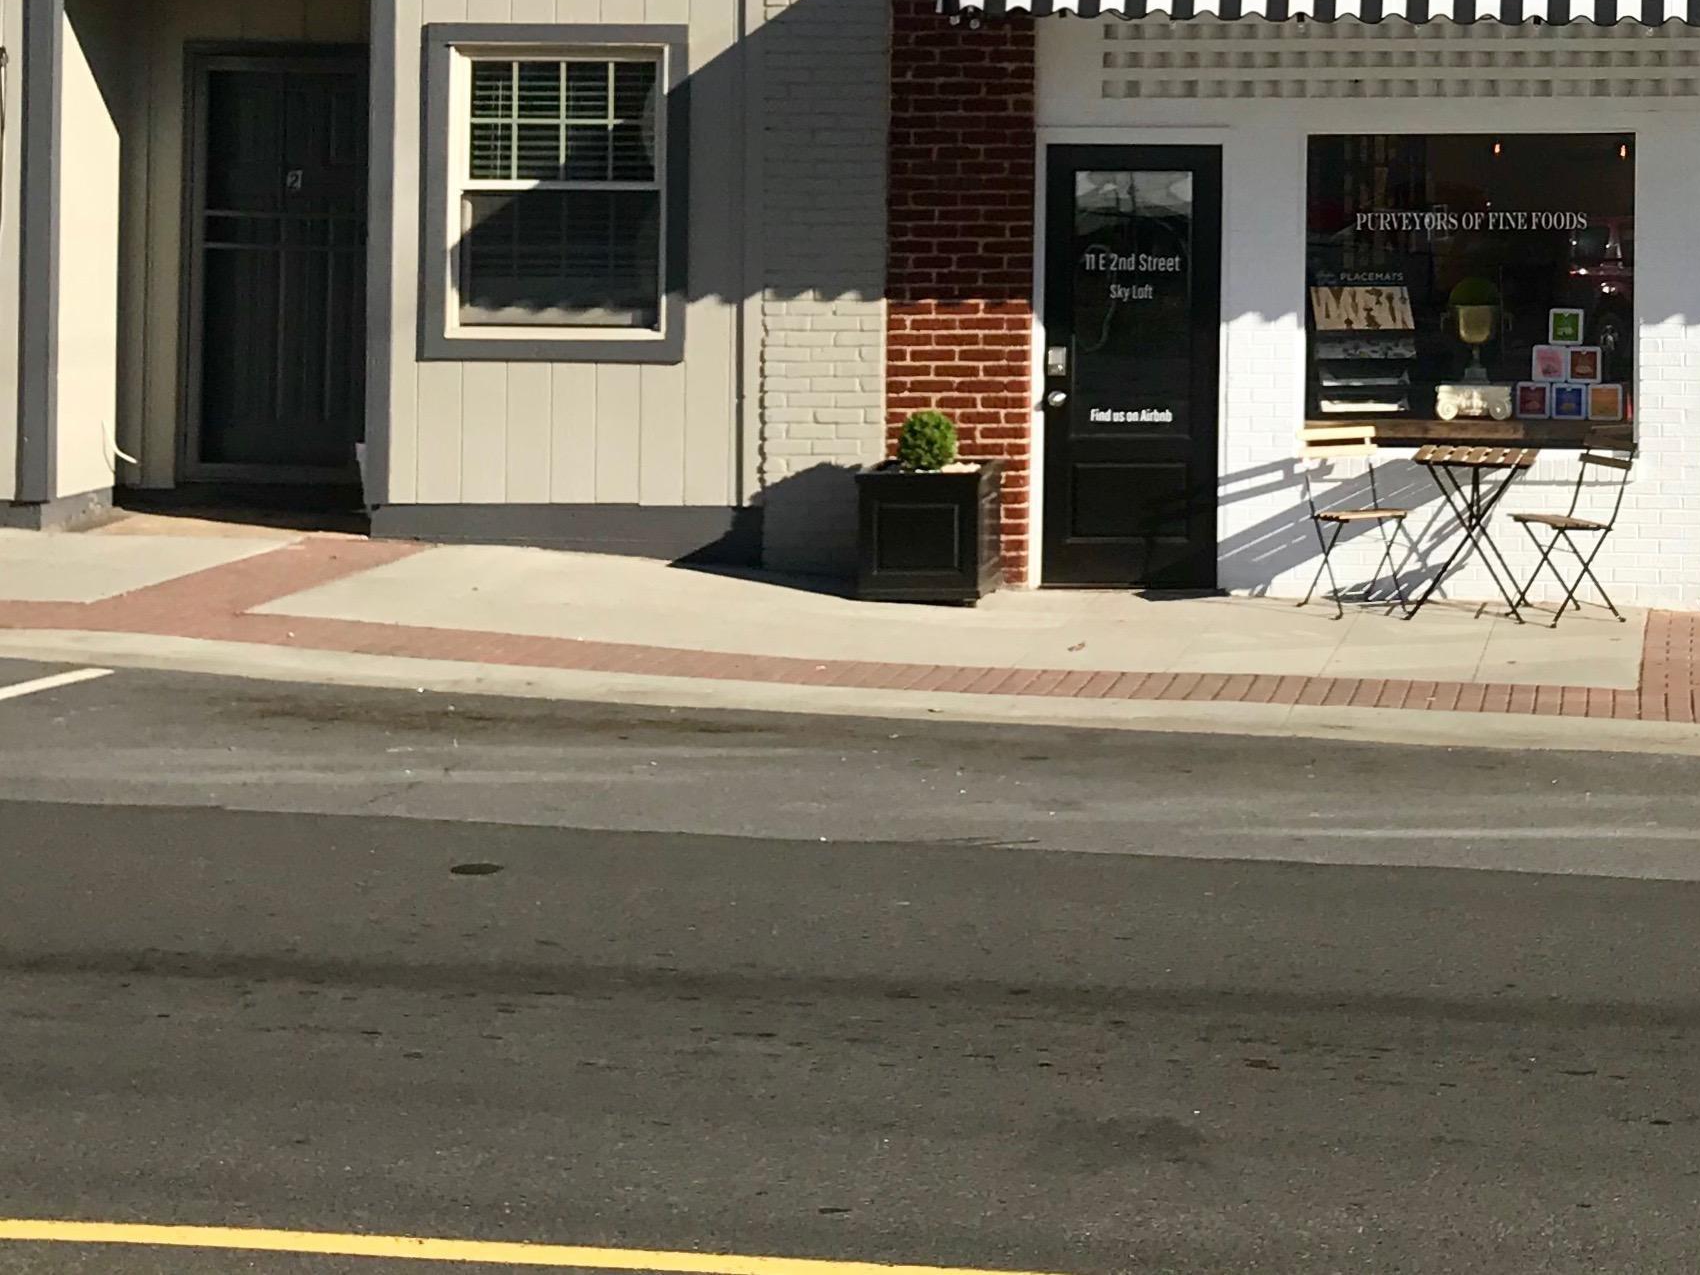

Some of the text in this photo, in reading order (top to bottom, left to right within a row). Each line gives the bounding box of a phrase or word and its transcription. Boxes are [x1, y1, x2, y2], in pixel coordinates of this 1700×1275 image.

[1356, 212, 1588, 231] PURVEYORS OF FINE FOODS
[1099, 253, 1106, 271] E
[1110, 253, 1135, 271] 2nd
[1139, 253, 1181, 272] Street
[1339, 272, 1404, 281] PLACEMATS
[1110, 284, 1153, 301] Sky Loft
[1090, 408, 1173, 423] Find us on Airbnb
